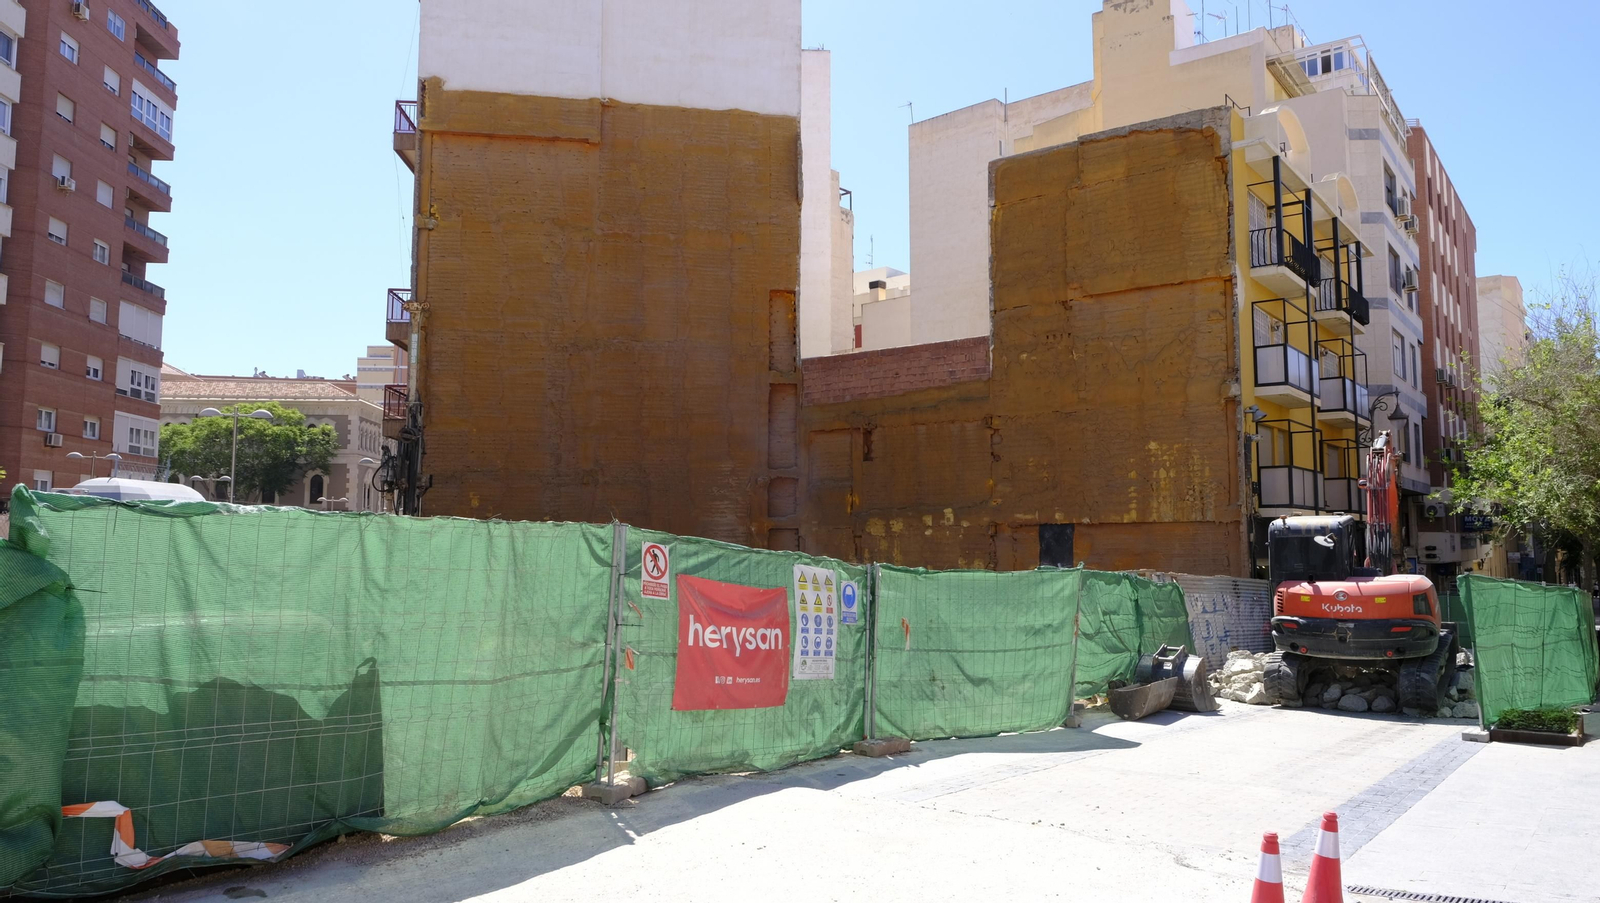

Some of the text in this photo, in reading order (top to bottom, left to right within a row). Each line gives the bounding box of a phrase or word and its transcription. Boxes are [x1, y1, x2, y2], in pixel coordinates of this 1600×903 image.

[1321, 603, 1363, 613] Kubota
[687, 614, 782, 657] herysan
[735, 676, 761, 685] herysan.es
